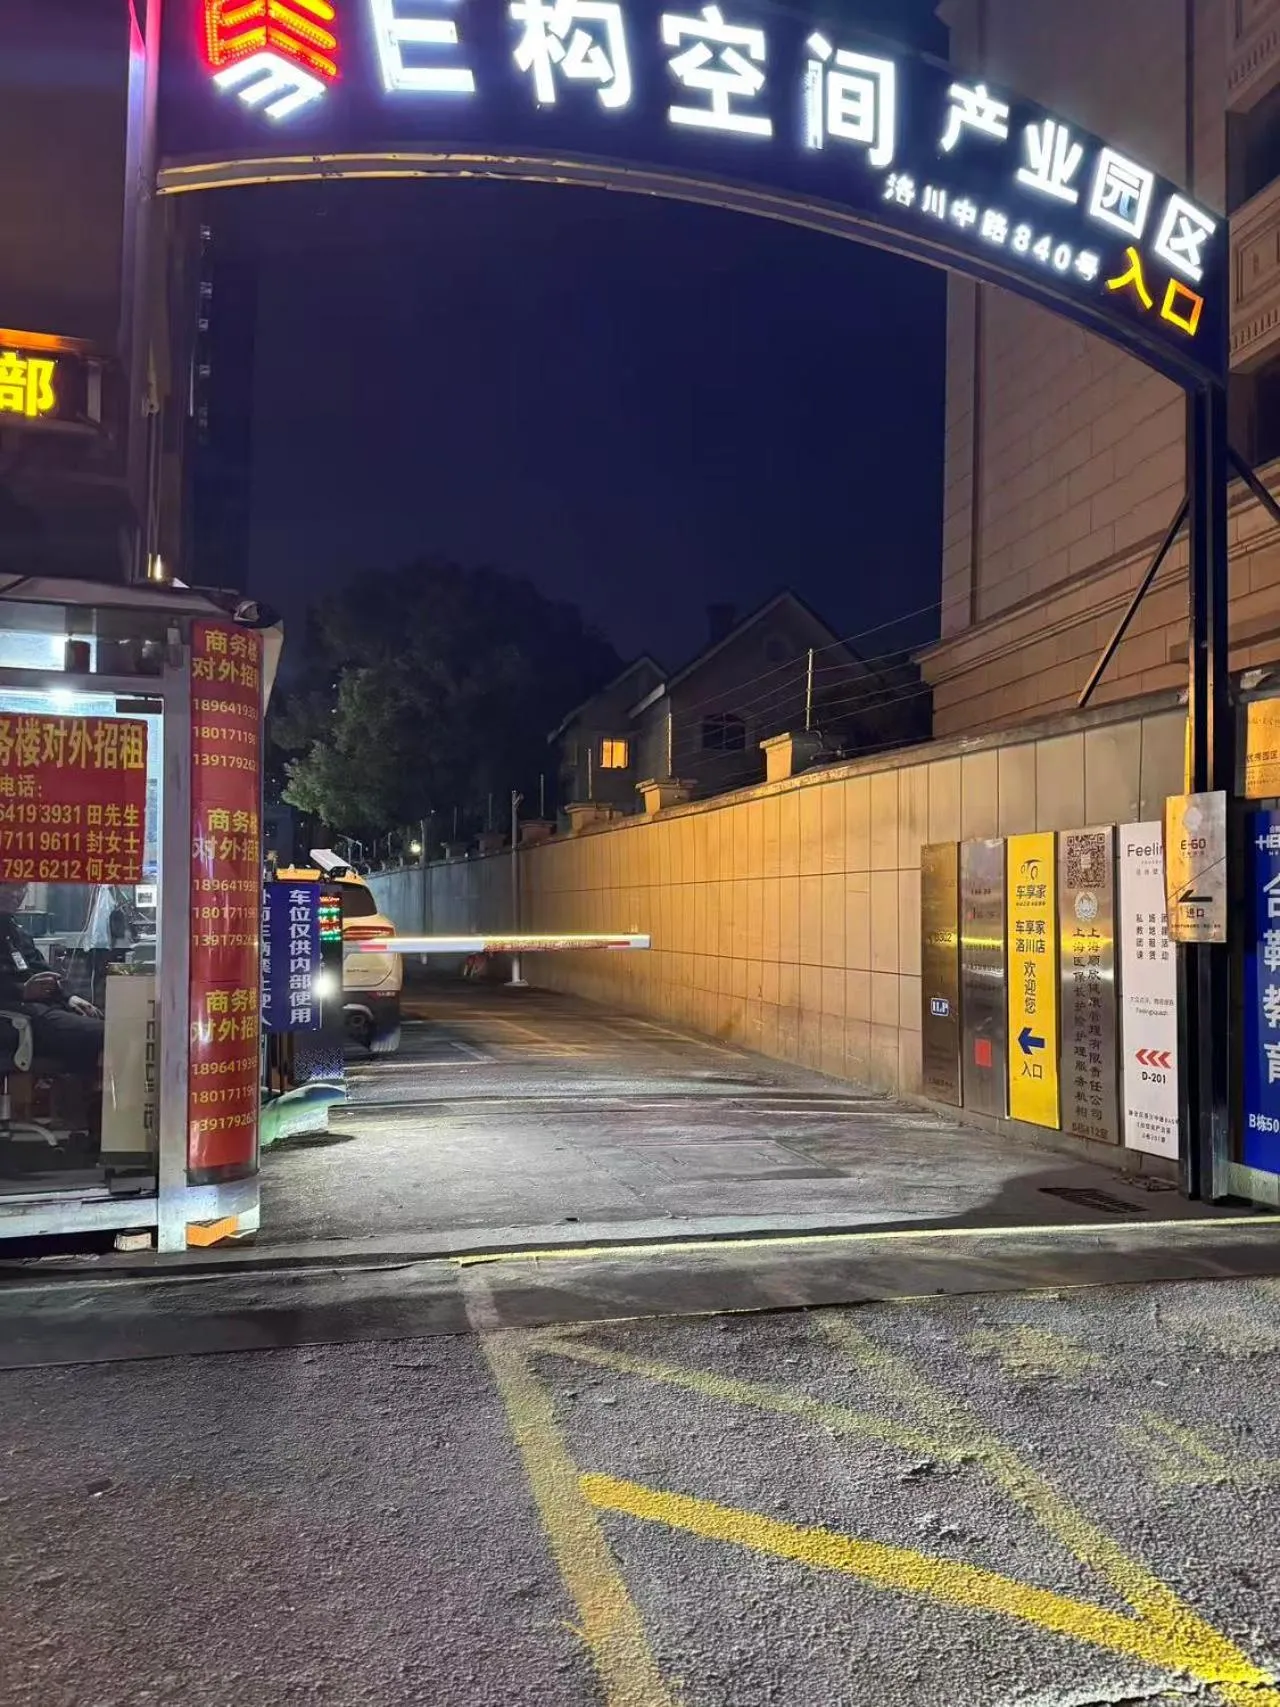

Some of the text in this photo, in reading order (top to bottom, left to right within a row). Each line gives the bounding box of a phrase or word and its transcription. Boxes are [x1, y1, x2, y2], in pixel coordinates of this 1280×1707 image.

[940, 82, 1216, 281] 产业园区
[1106, 246, 1204, 336] 入口
[0, 352, 56, 417] 部
[40, 804, 81, 825] 3931
[86, 803, 140, 827] 田先生
[40, 831, 81, 852] 9611
[86, 830, 140, 853] 封女士
[39, 859, 81, 880] 6212
[86, 857, 139, 882] 何女士
[1015, 919, 1046, 935] 车享家
[288, 889, 312, 1025] 车位仅供内部使用
[1015, 938, 1046, 953] 洛川店
[1023, 960, 1037, 1015] 欢迎您
[1021, 1060, 1043, 1080] 入口
[1141, 1071, 1167, 1085] D-201
